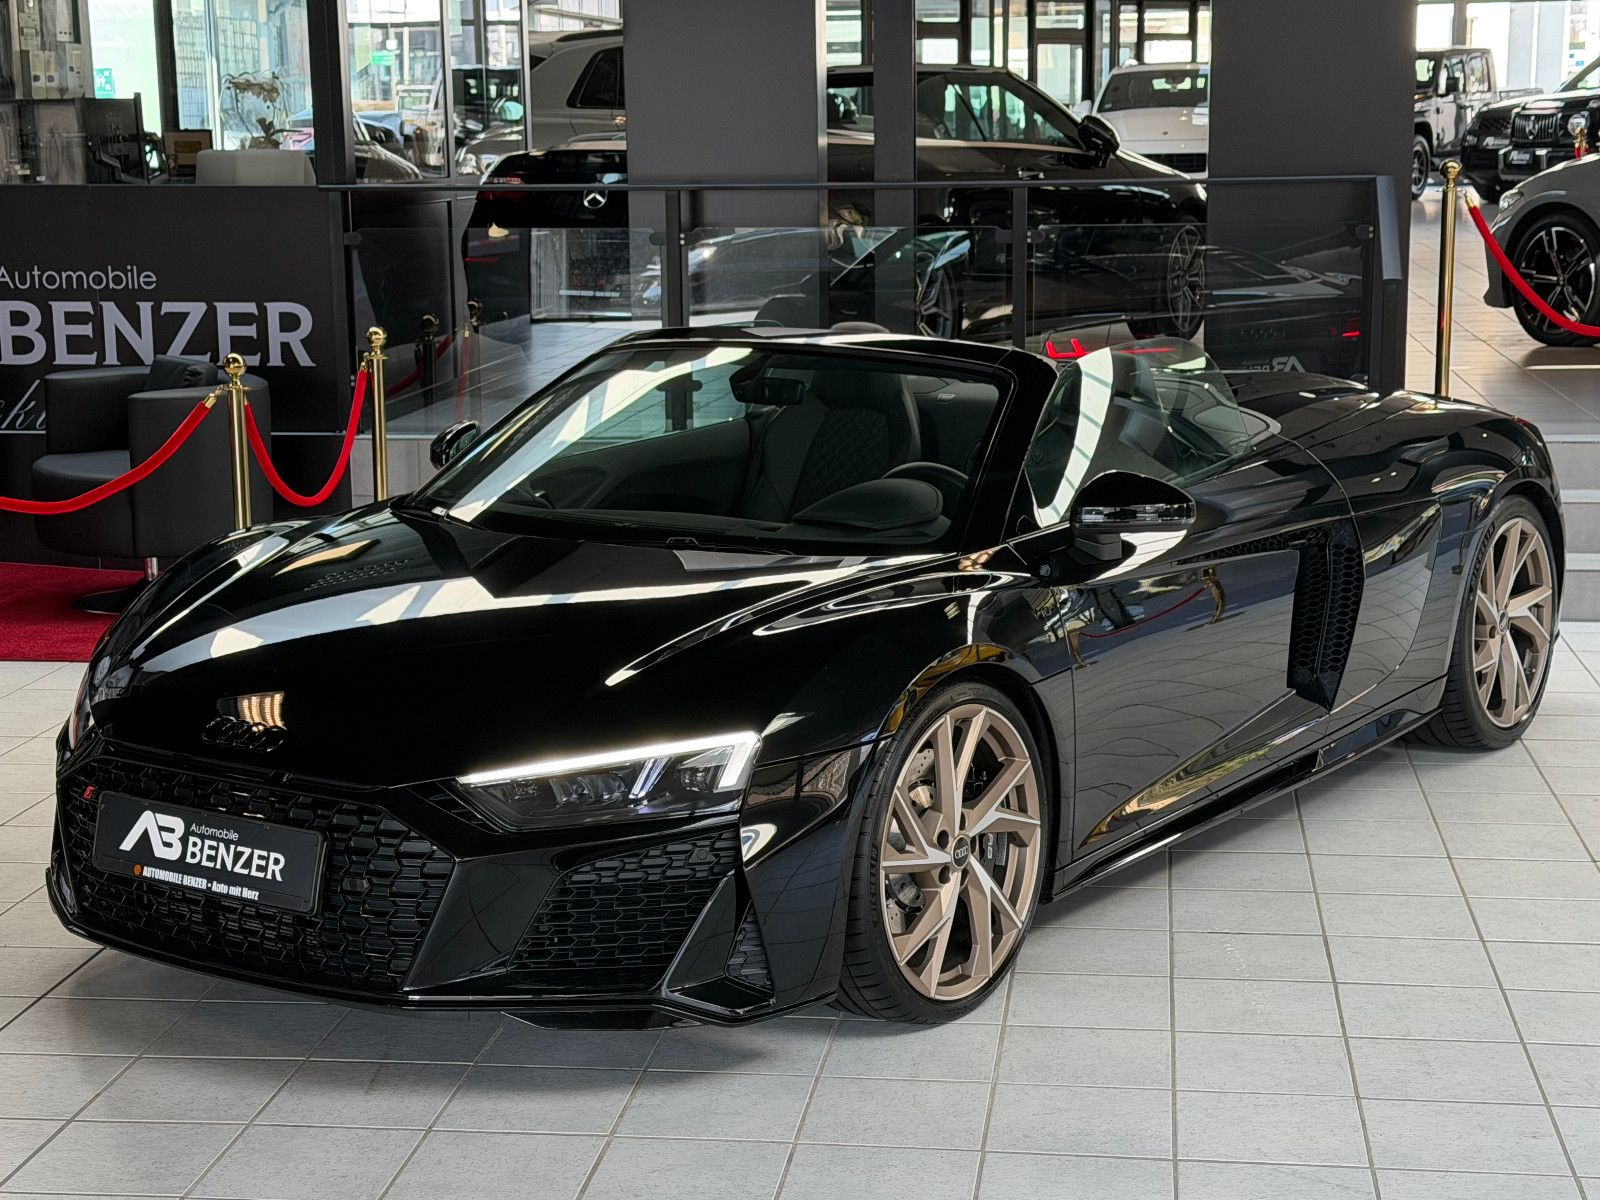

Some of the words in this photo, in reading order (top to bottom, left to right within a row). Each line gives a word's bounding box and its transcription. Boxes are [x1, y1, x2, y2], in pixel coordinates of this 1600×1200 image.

[0, 265, 157, 290] Automobile
[0, 300, 317, 367] BENZER
[189, 823, 239, 841] Automobile
[185, 835, 286, 882] BENZER
[142, 866, 183, 885] AUTOMOBILE
[182, 875, 208, 890] BENZER
[211, 881, 229, 894] Auto
[228, 886, 242, 897] mit
[242, 887, 260, 901] Herz
